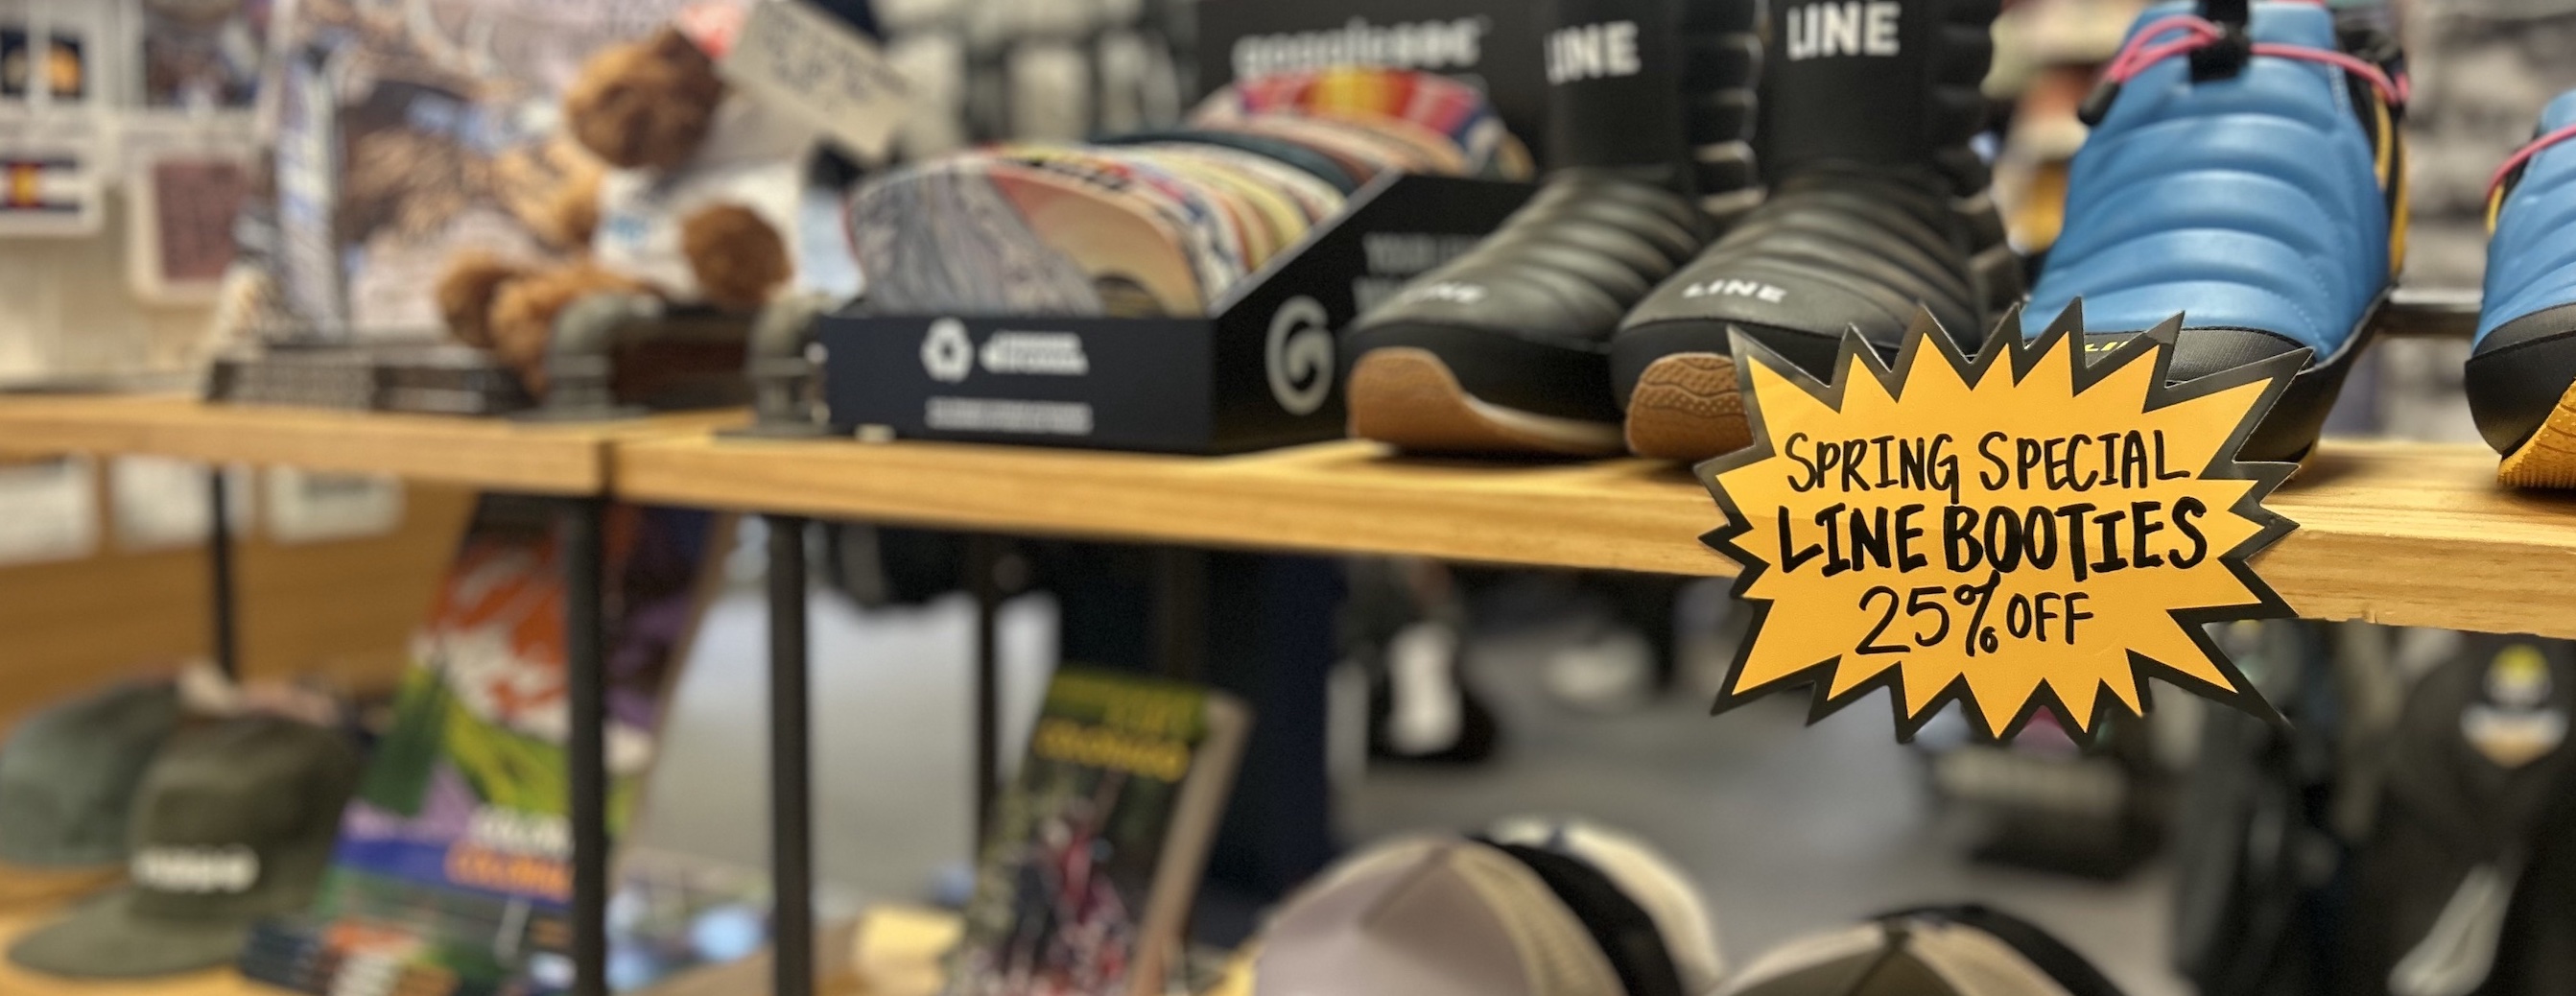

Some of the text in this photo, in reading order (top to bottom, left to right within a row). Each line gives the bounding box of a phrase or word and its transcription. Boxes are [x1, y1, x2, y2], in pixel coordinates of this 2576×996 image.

[1544, 21, 1641, 84] LINE
[1786, 3, 1902, 60] LINE
[1682, 280, 1786, 303] LINE
[1785, 430, 2190, 504] SPRING SPECIAL
[1779, 496, 2208, 582] LINE BOOTIES
[1855, 570, 2093, 656] 25% OFF
